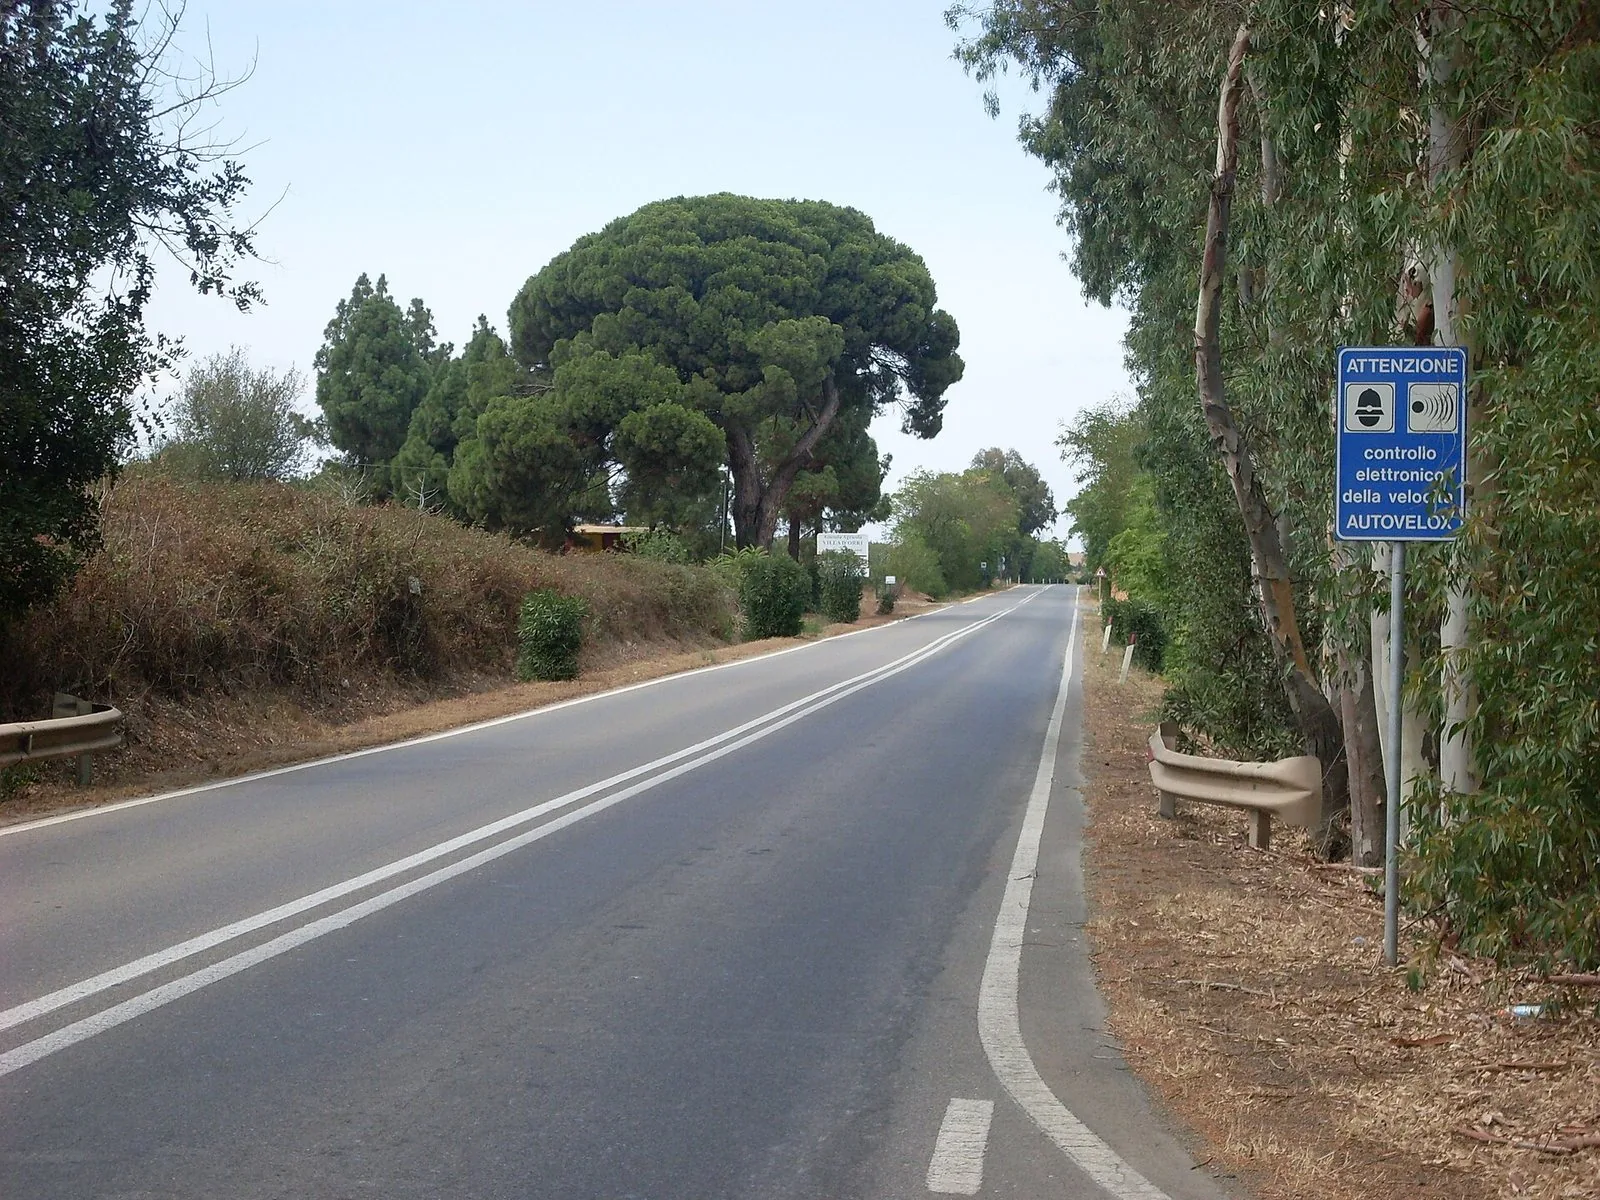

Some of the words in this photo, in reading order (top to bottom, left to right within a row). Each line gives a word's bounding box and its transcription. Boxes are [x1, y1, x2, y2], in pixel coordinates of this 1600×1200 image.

[1346, 358, 1459, 374] ATTENZIONE
[1363, 446, 1437, 460] controllo
[1355, 467, 1444, 482] elettronico
[1342, 489, 1381, 504] della
[1346, 514, 1453, 530] AUTOVELOX
